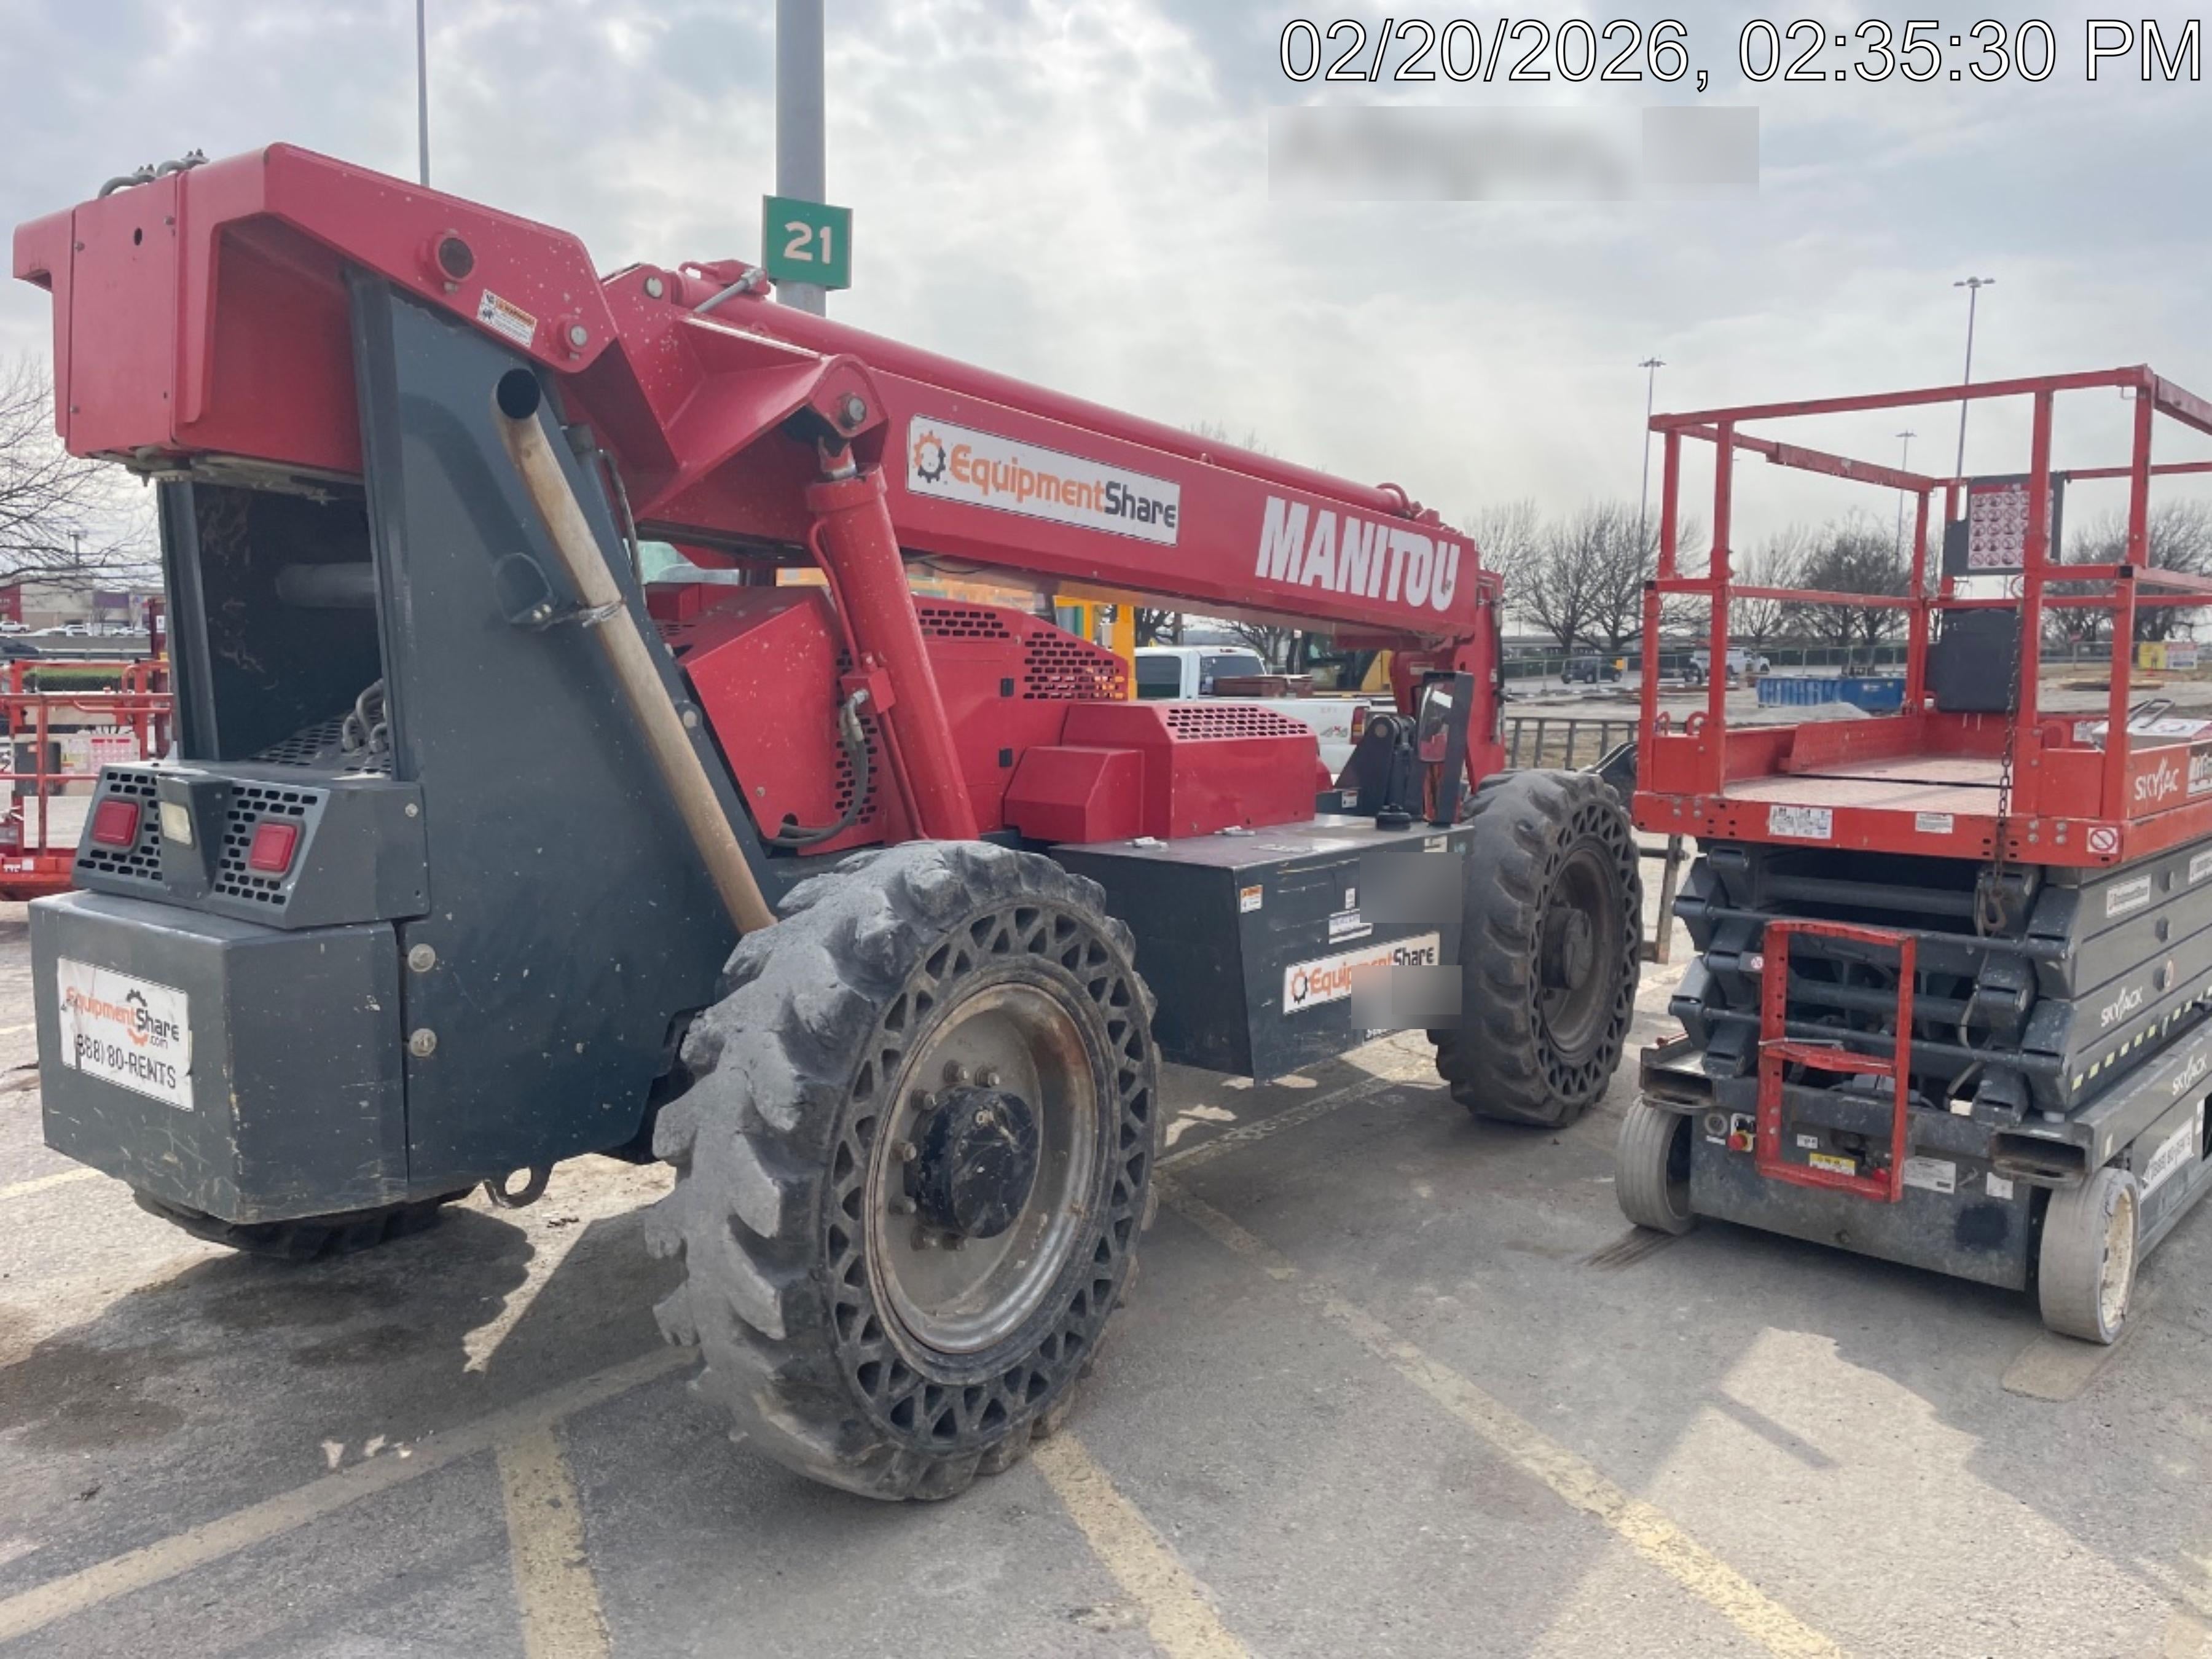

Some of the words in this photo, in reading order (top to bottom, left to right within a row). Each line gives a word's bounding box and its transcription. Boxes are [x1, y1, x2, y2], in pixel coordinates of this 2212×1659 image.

[783, 221, 831, 264] 21
[950, 443, 1177, 528] EquipmentShare
[1255, 495, 1461, 612] MANITOU
[66, 986, 179, 1041] EquipmentShare
[107, 1045, 176, 1089] 80-RENTS
